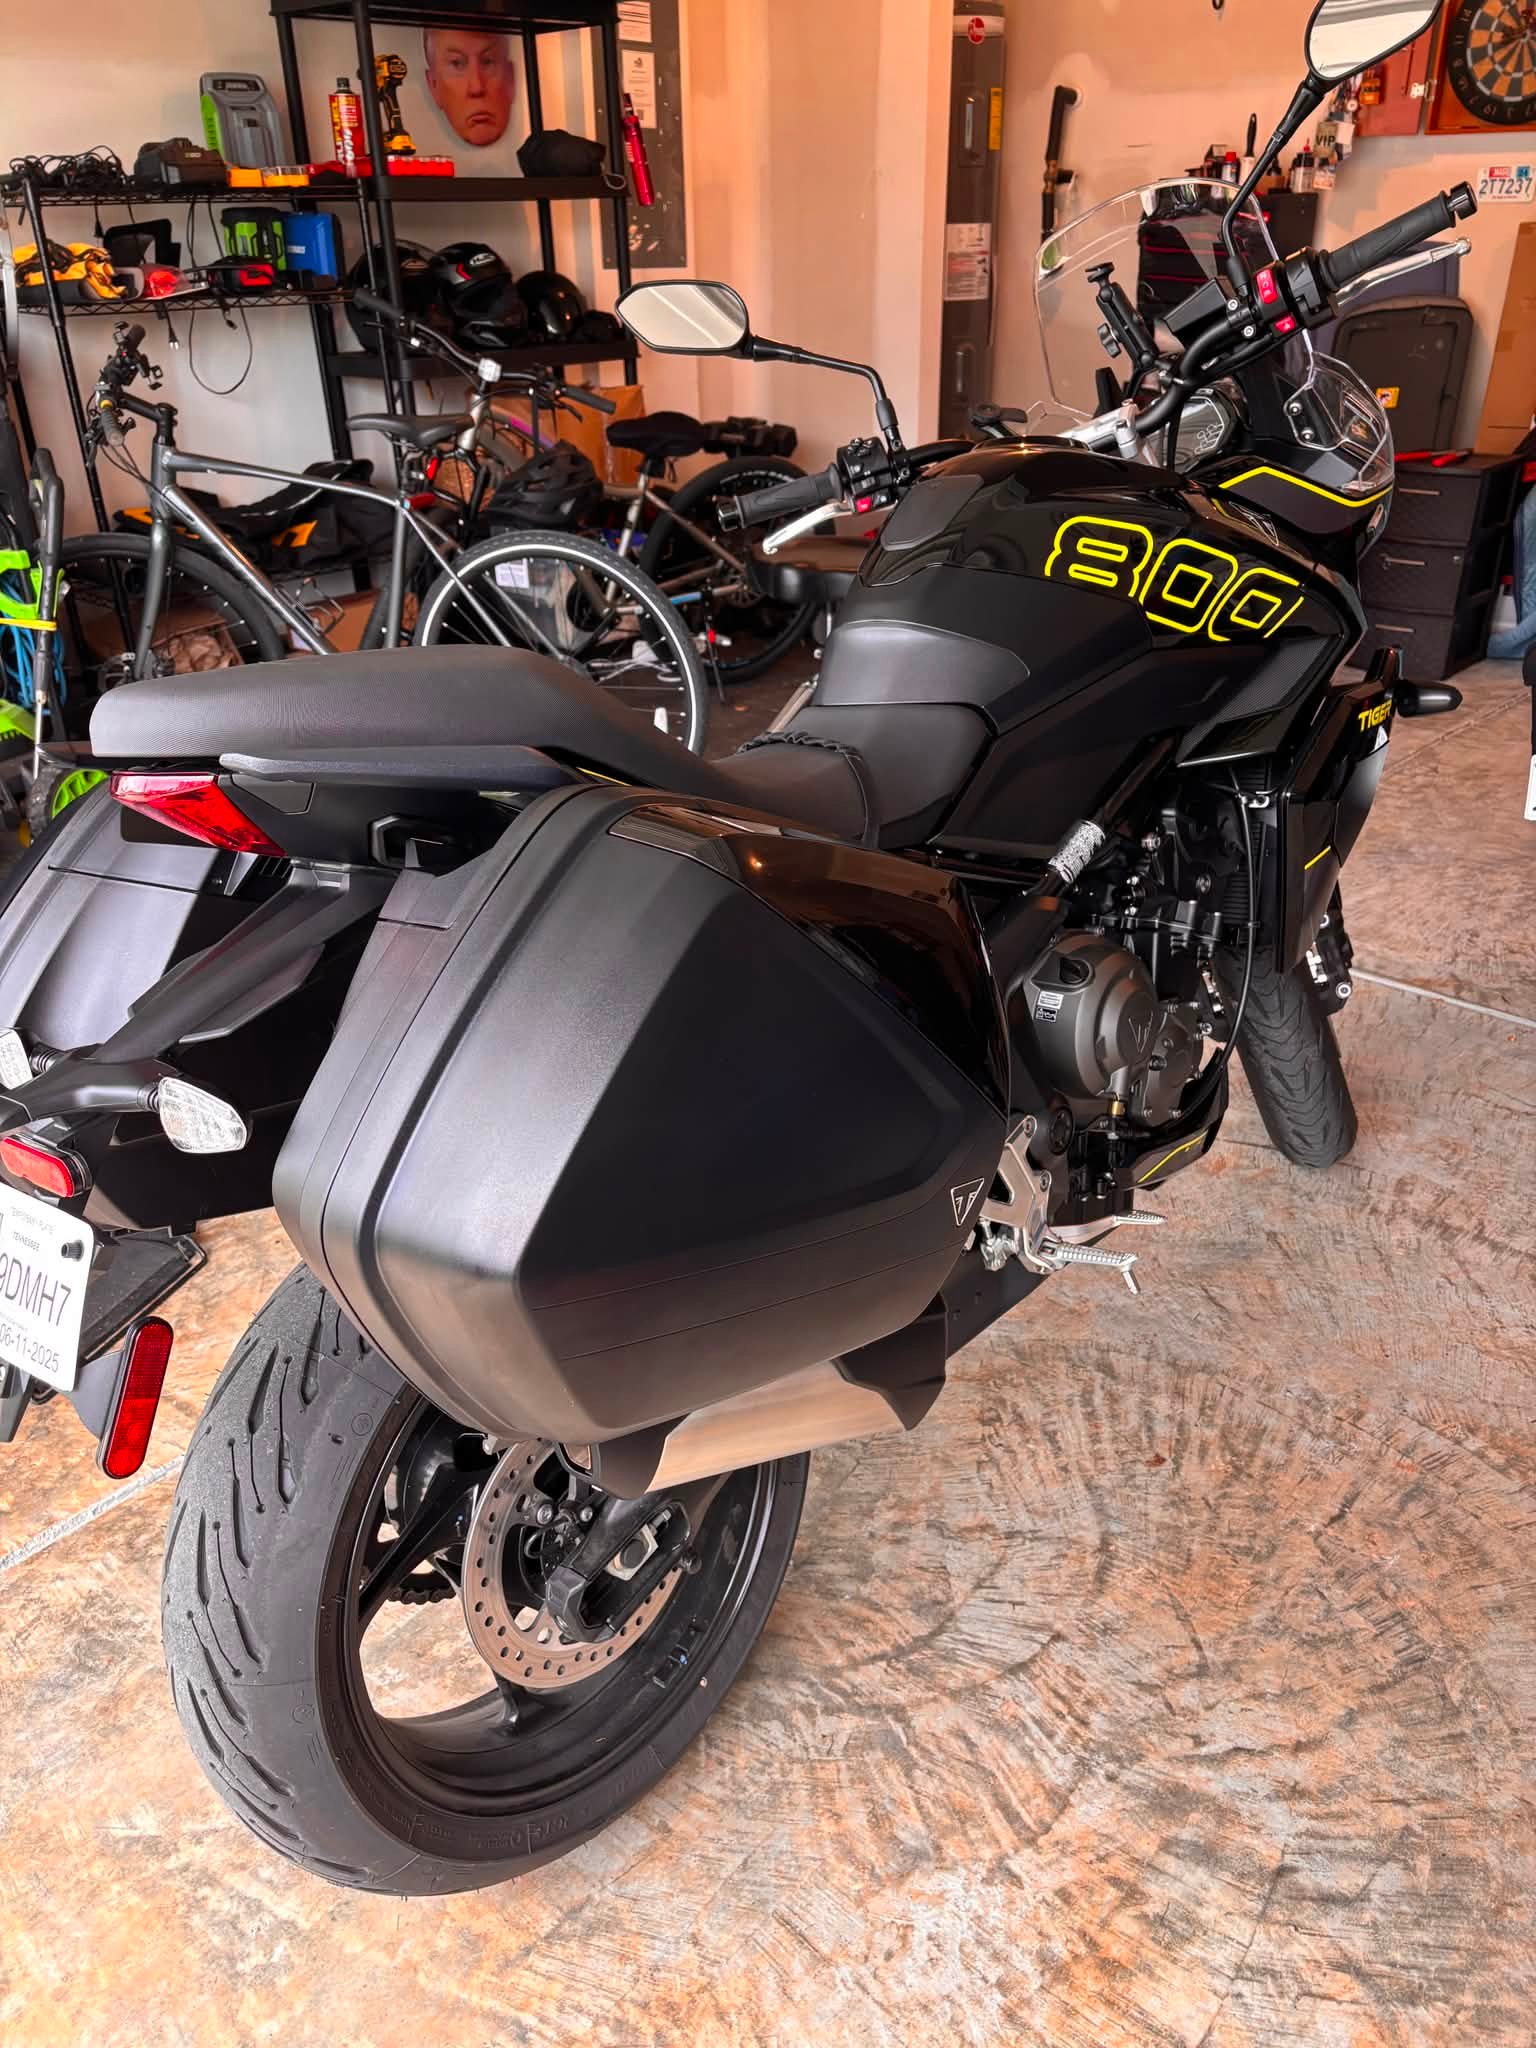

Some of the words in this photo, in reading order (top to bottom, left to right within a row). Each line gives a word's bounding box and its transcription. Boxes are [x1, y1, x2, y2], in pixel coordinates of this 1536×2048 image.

[1315, 135, 1336, 147] VIP
[1479, 177, 1532, 194] 2T7237
[1045, 516, 1304, 641] 800
[1358, 700, 1392, 732] TIGER
